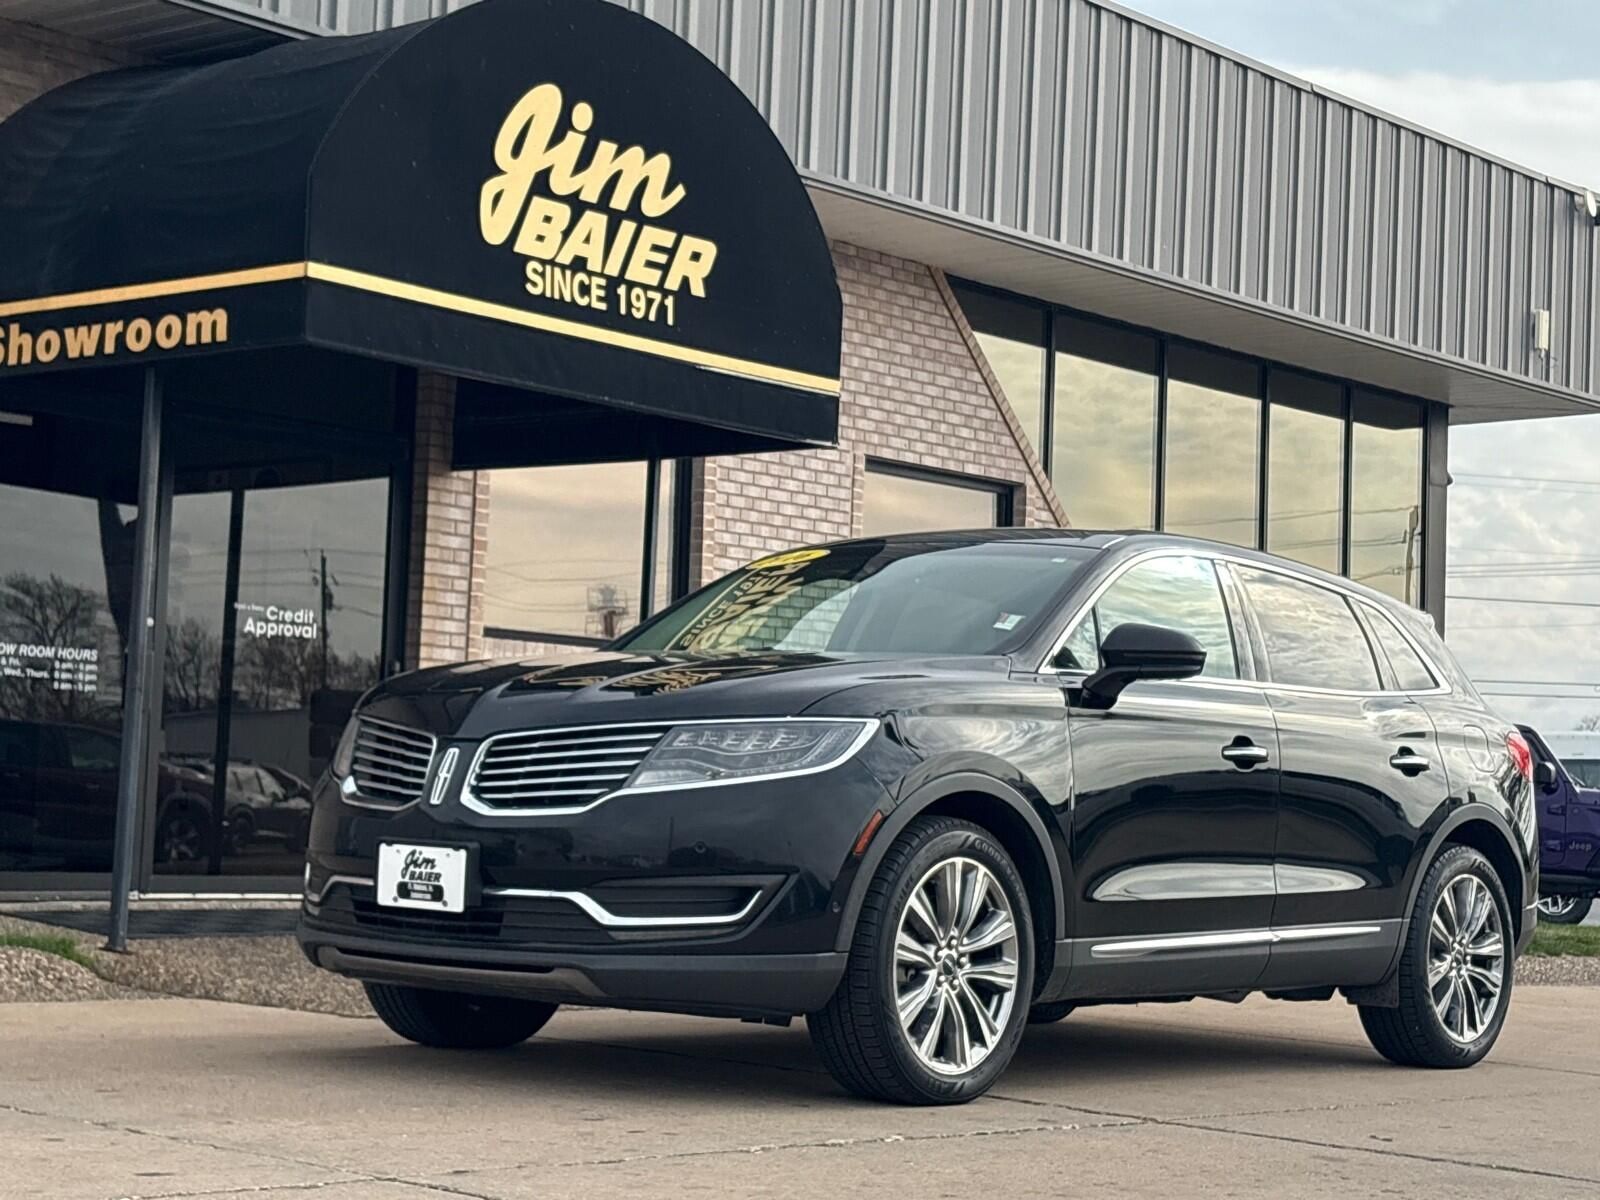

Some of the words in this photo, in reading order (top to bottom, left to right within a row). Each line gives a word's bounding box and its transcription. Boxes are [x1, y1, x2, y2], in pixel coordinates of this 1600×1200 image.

[479, 83, 686, 246] Jim
[513, 195, 718, 298] BAIER
[525, 260, 608, 311] SINCE
[616, 283, 675, 326] 1971
[0, 308, 228, 366] howroom
[266, 605, 314, 624] Credit
[243, 617, 317, 639] Approval
[19, 644, 55, 658] ROOM
[57, 647, 98, 662] HOURS
[1568, 840, 1592, 853] Jeep
[401, 850, 436, 879] Jim
[409, 870, 441, 883] BAIER
